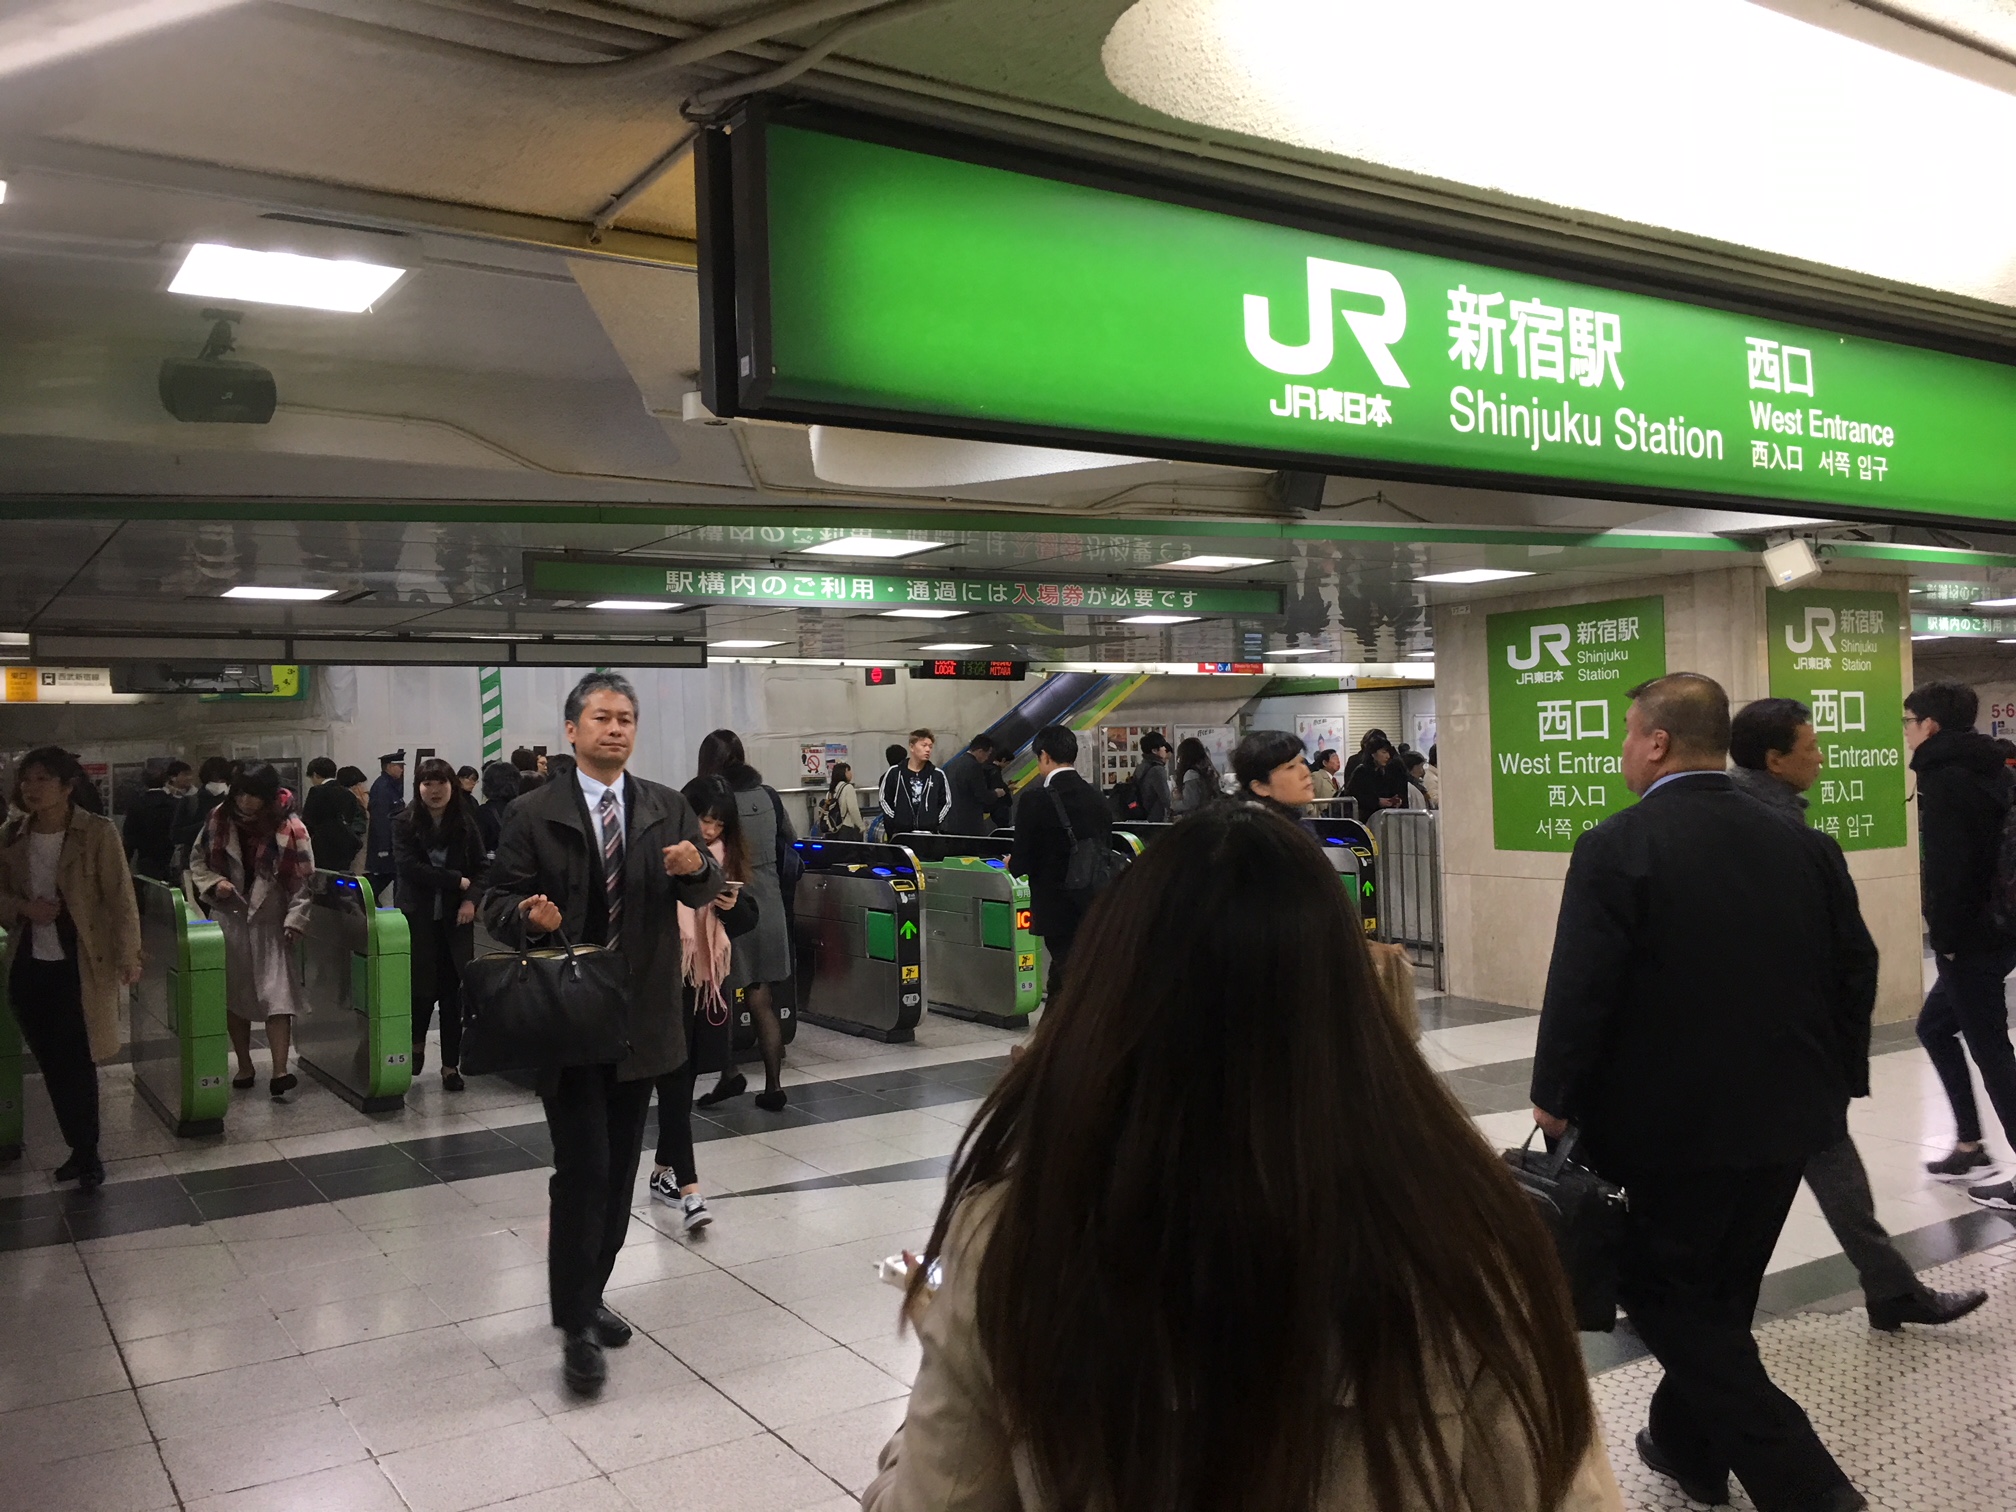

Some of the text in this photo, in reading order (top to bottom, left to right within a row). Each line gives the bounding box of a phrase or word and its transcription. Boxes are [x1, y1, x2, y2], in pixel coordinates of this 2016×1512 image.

[1243, 256, 1411, 389] JR
[1447, 284, 1625, 391] 新宿駅
[1745, 336, 1814, 398] 西口
[1269, 384, 1392, 428] JR東日本
[1450, 385, 1723, 460] Shinjuku Station
[1749, 400, 1895, 447] West Entrance
[1750, 440, 1803, 471] 西入口
[1818, 450, 1889, 482] 서쪽 입구
[1577, 616, 1640, 645] 新宿駅
[1785, 606, 1837, 654] JR
[1840, 609, 1884, 634] 新宿駅
[1506, 623, 1572, 670] JR
[1577, 648, 1628, 665] Shinjuku
[1840, 639, 1877, 656] Shinjuku
[1577, 667, 1620, 682] Station
[1793, 657, 1832, 670] JR東日本
[1841, 657, 1872, 671] Station
[1516, 670, 1564, 685] JR東日本
[1536, 699, 1610, 742] 西口
[1811, 689, 1866, 733] 西口
[1498, 751, 1623, 775] West Entra
[1828, 744, 1899, 769] Entrance
[1547, 785, 1606, 807] 西入口
[1820, 780, 1864, 804] 西入口
[1536, 818, 1573, 840] 서쪽
[1846, 814, 1875, 838] 입구
[1016, 911, 1031, 929] IC
